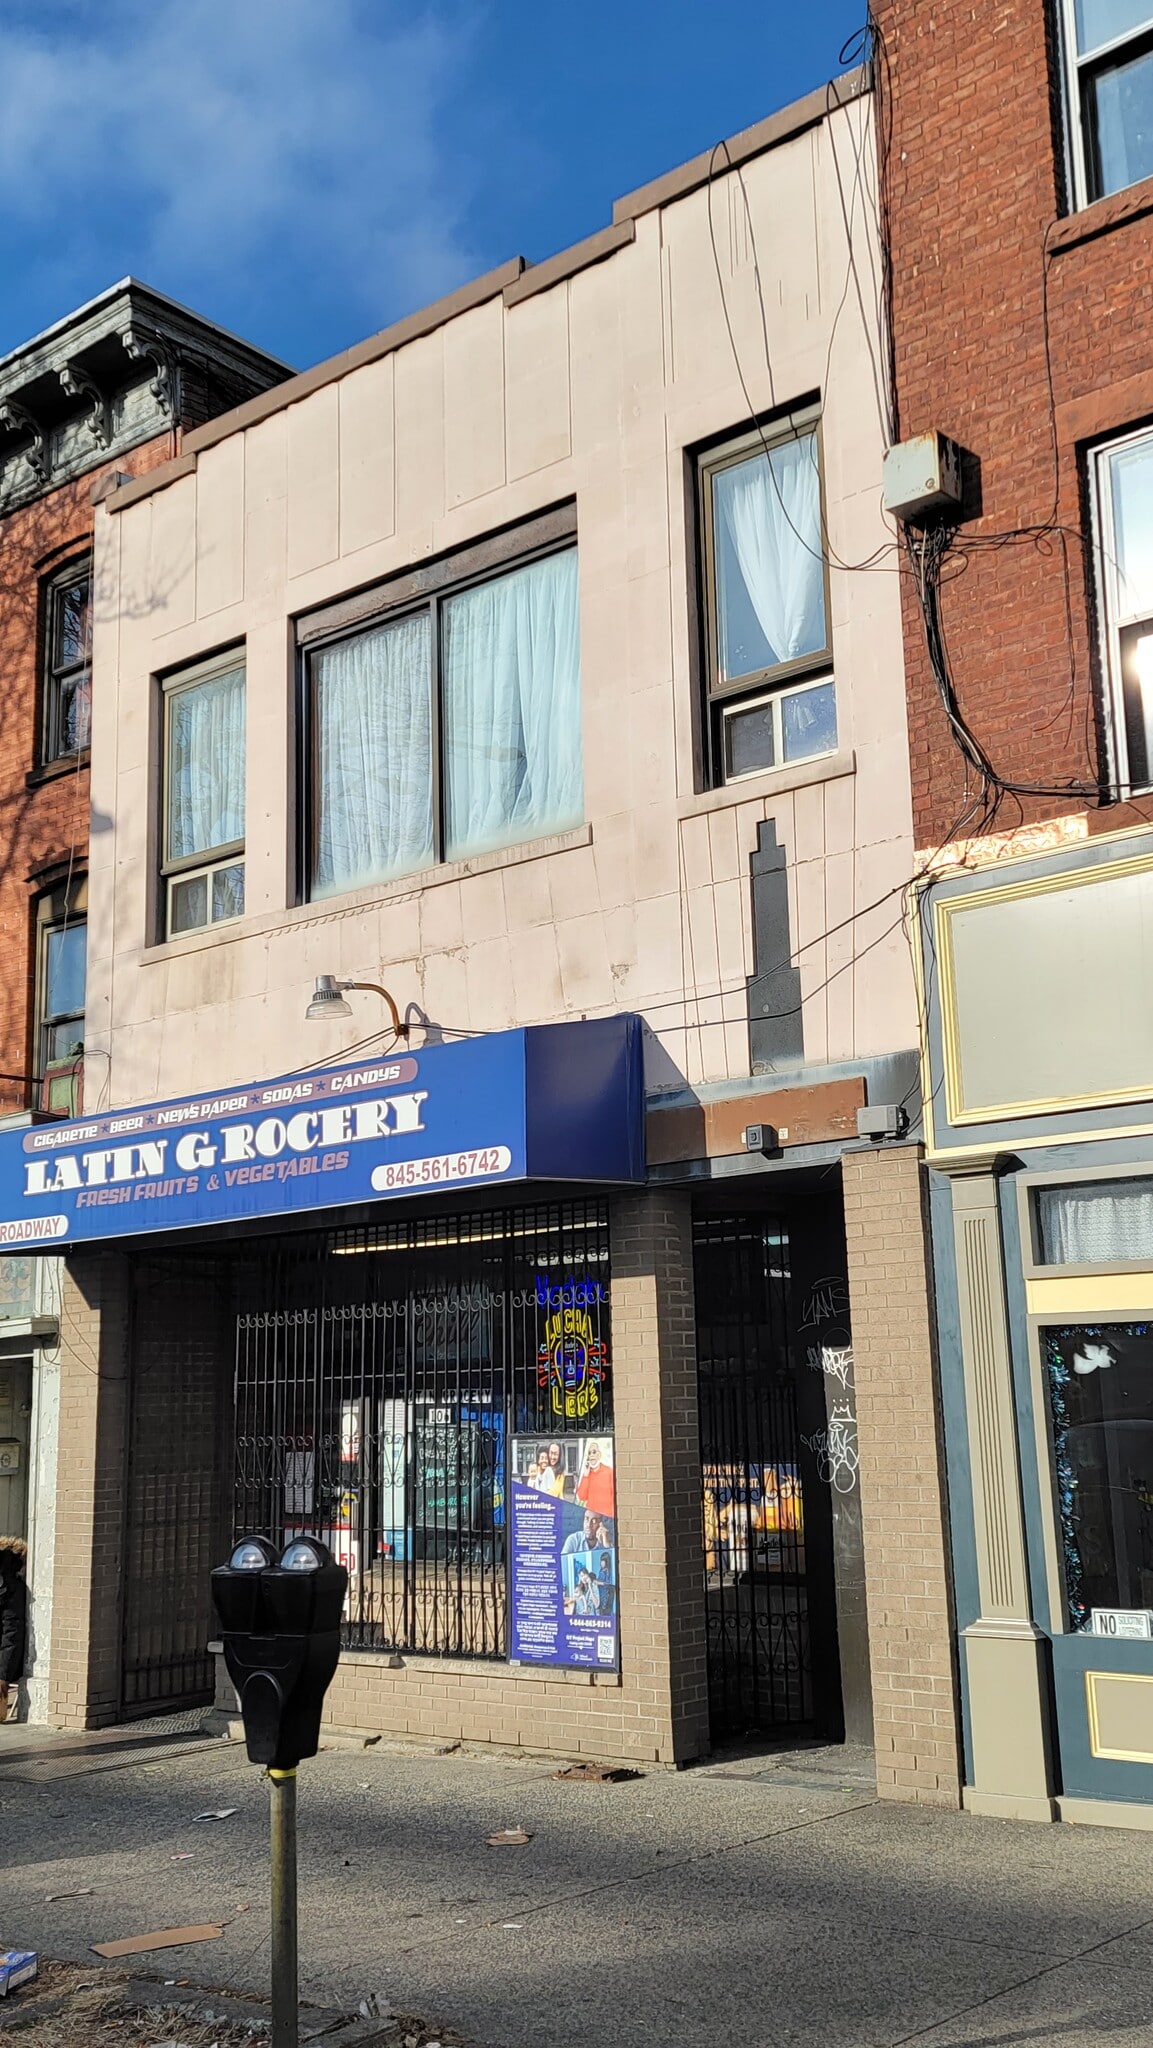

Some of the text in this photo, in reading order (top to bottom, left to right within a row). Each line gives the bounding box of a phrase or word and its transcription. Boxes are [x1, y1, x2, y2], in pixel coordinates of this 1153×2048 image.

[109, 1116, 144, 1134] BEER
[262, 1083, 313, 1104] SODAS
[330, 1065, 401, 1093] CANDYS
[23, 1139, 168, 1196] LATIN
[76, 1150, 350, 1209] FRESH FRUITS & VEGETABLES
[385, 1149, 500, 1187] 845-561-6742
[545, 1308, 593, 1349] LUCHA
[552, 1379, 599, 1417] LBRE
[1099, 1614, 1117, 1635] NO
